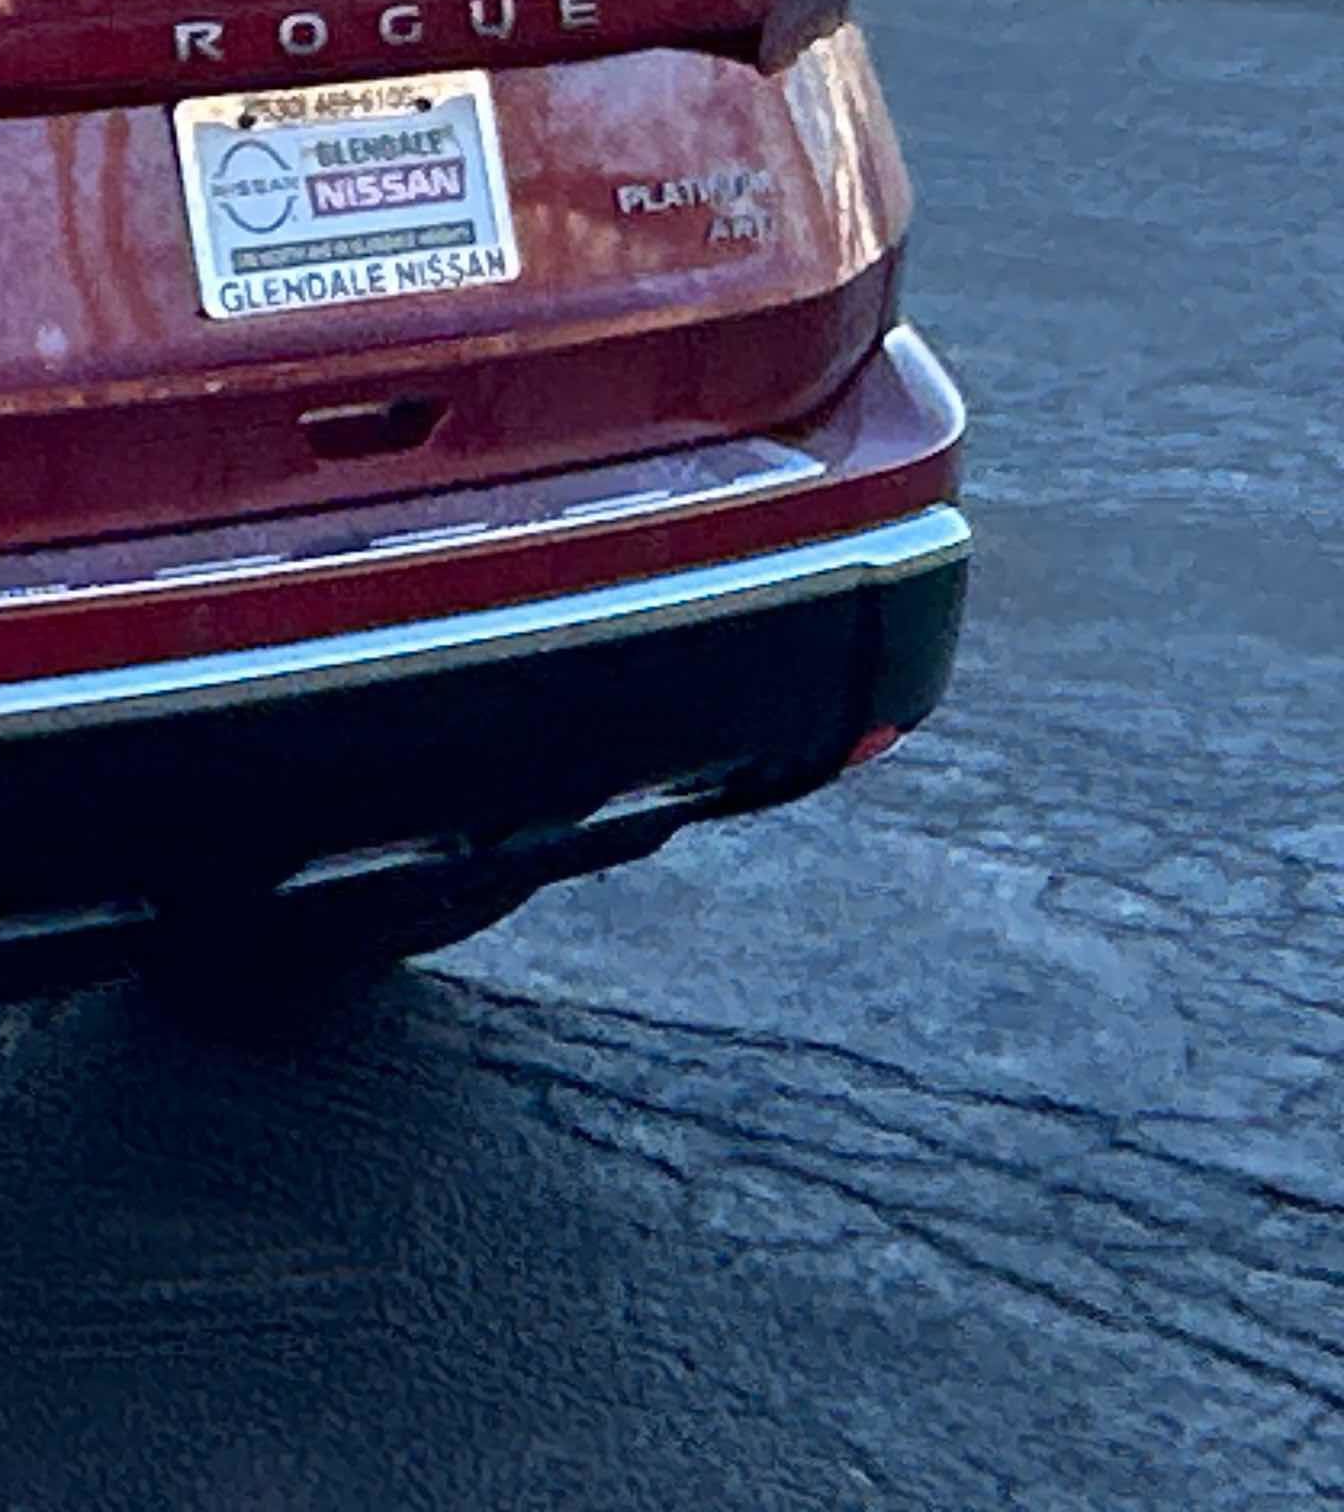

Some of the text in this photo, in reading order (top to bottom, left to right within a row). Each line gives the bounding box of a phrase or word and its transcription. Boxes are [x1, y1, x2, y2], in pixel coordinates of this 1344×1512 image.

[315, 165, 460, 210] NISSAN
[219, 262, 387, 313] GLENDALE
[395, 247, 506, 289] NISSAN
